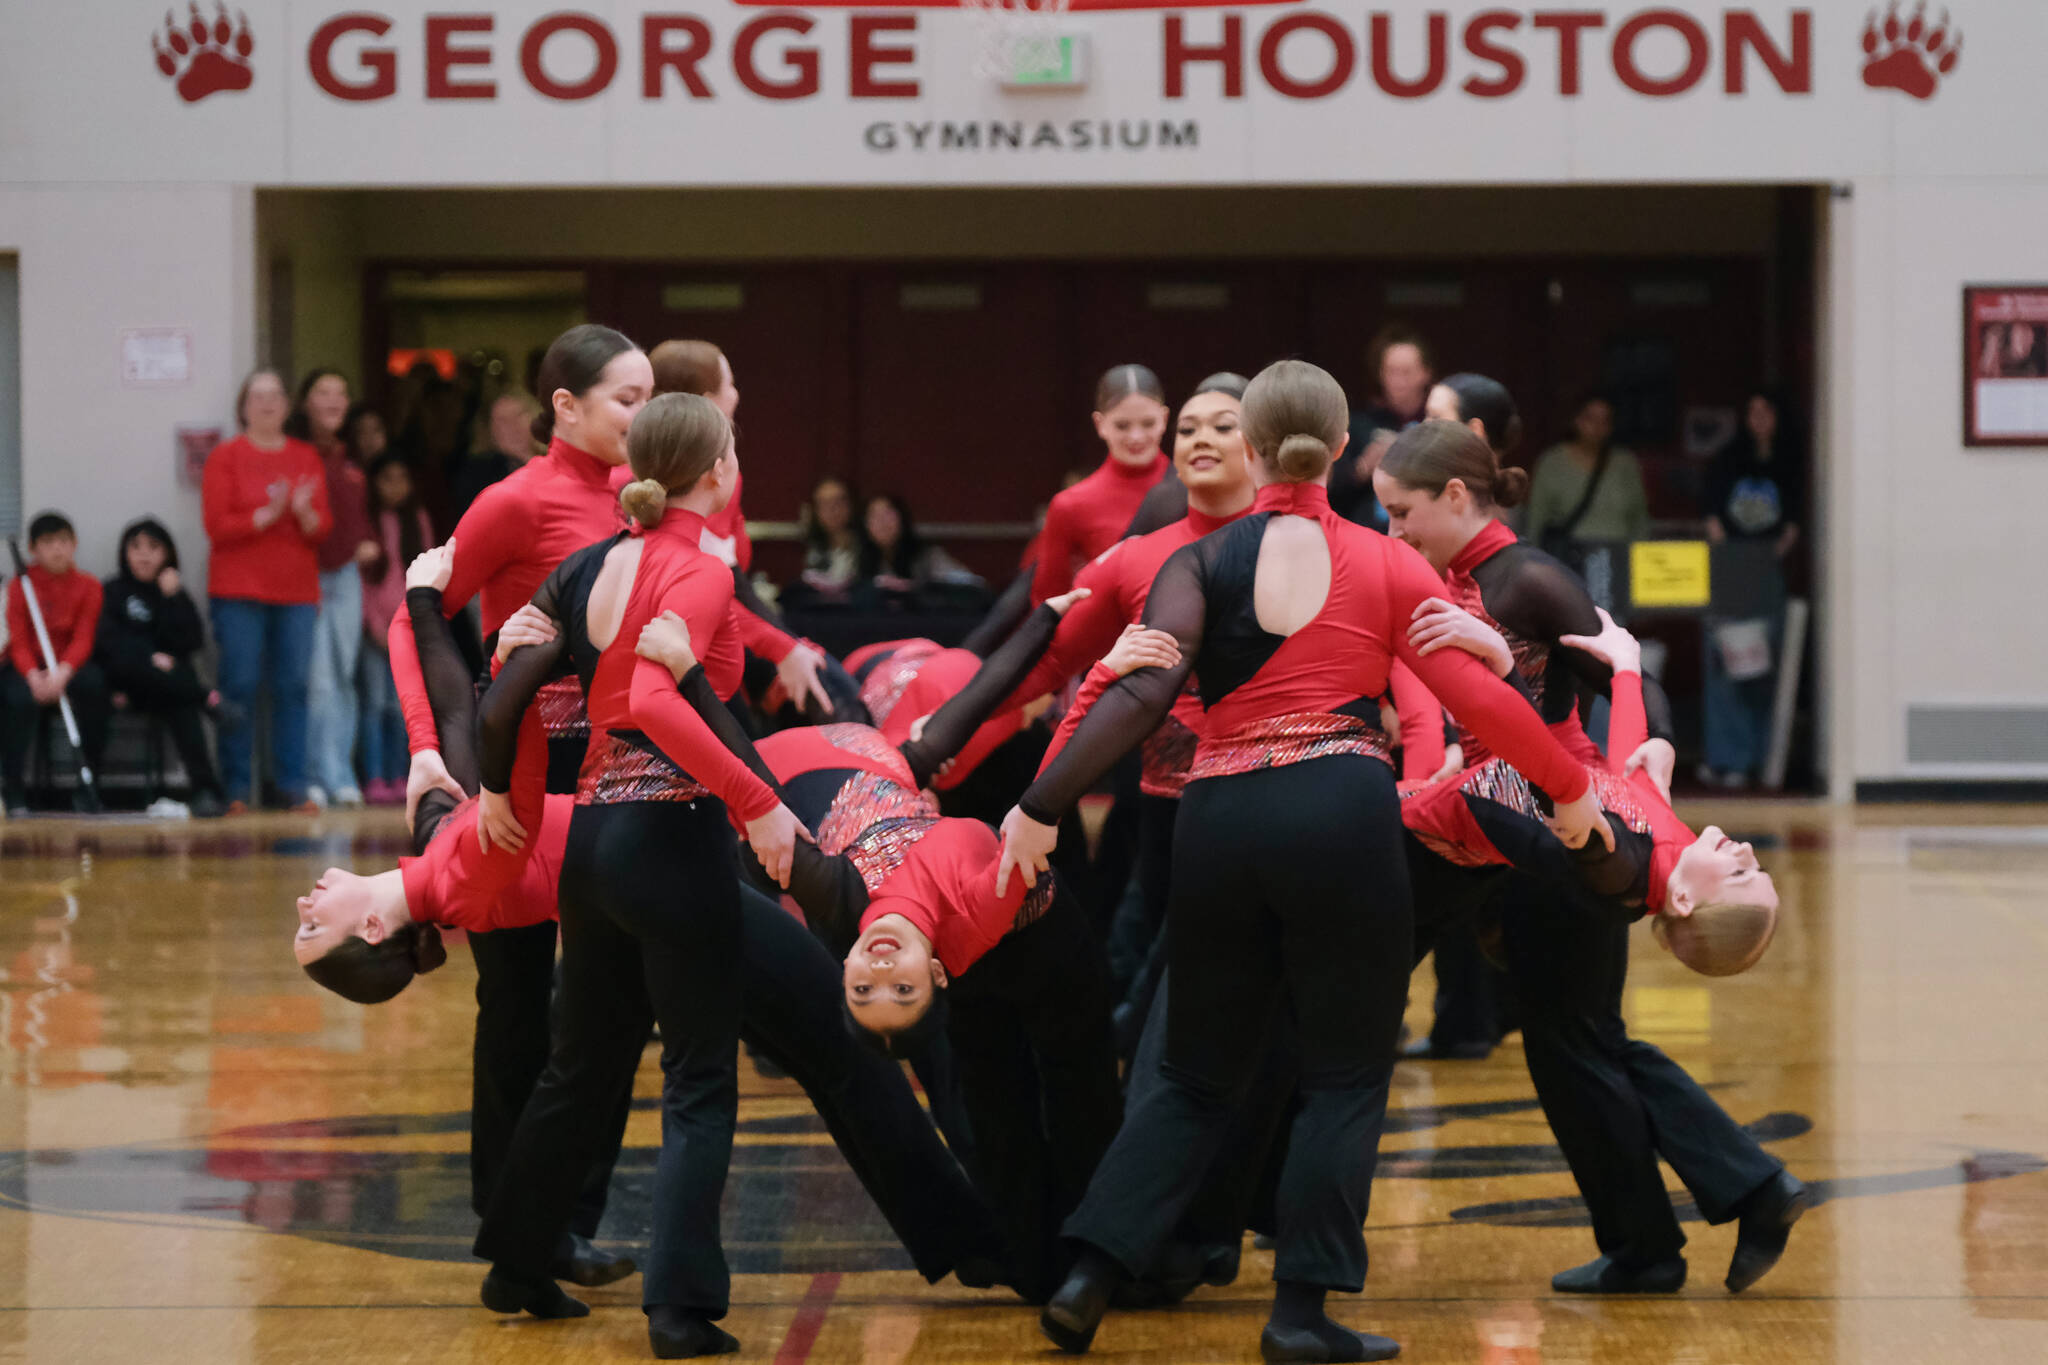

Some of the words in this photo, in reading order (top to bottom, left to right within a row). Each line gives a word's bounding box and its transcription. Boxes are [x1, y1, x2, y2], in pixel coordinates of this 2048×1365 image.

[306, 11, 920, 104] GEORGE
[1164, 8, 1813, 101] HOUSTON
[865, 121, 1198, 150] GYMNASIUM
